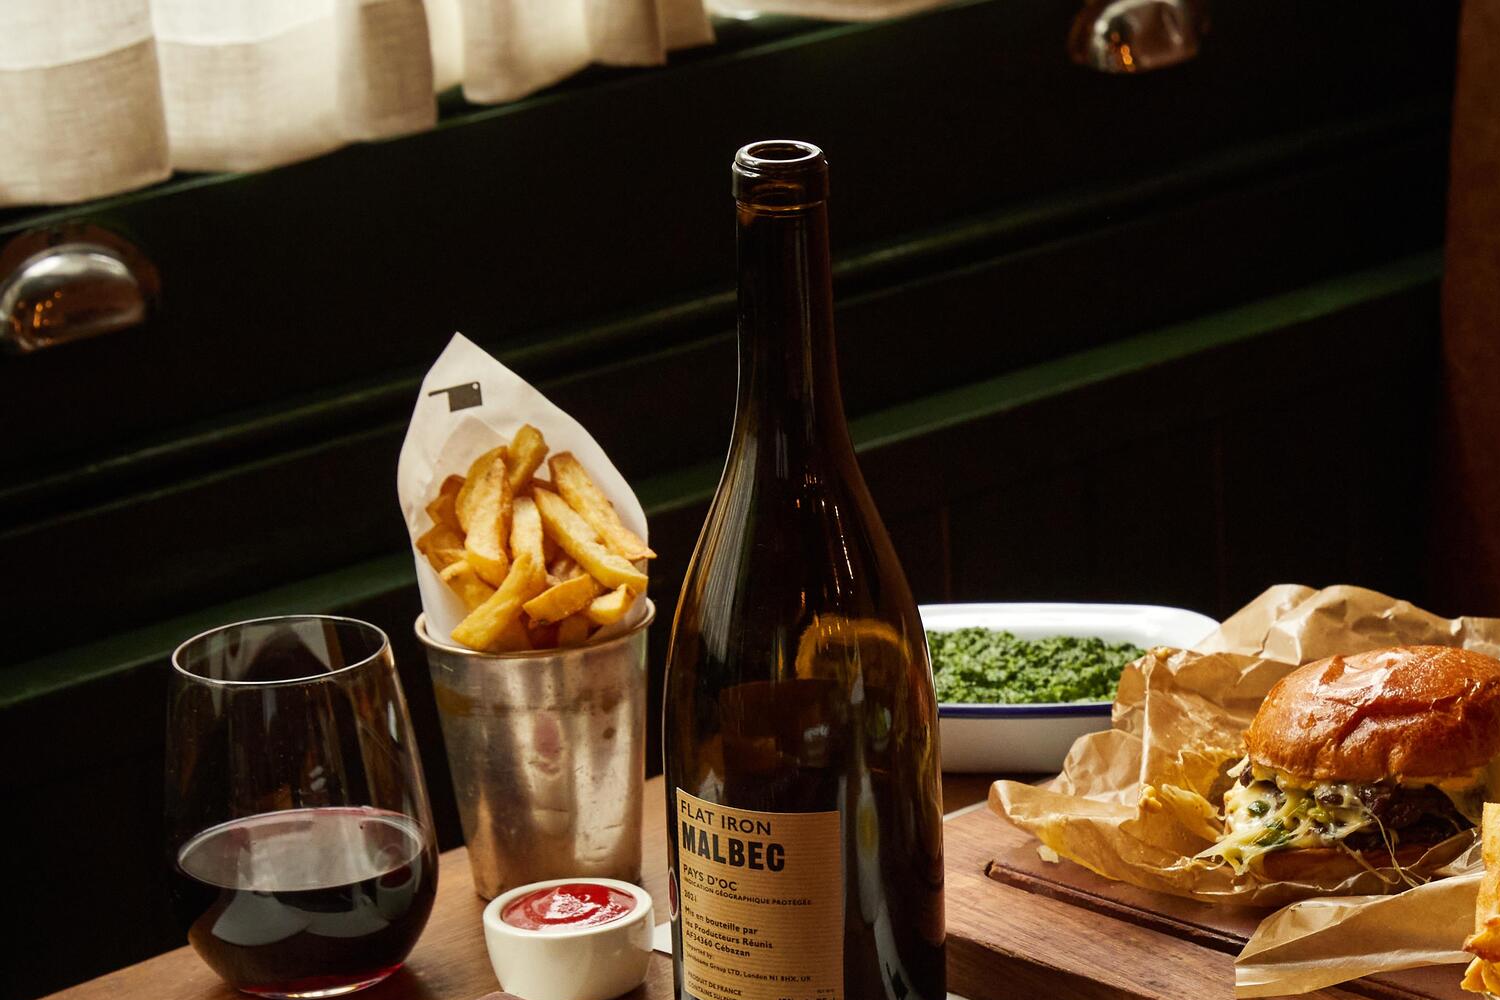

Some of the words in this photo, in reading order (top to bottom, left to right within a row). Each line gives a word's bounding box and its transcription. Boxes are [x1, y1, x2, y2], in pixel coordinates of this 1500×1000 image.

[681, 800, 714, 825] FLAT
[721, 815, 771, 836] IRON
[682, 821, 785, 872] MALBEC
[683, 864, 704, 881] PAYS
[707, 875, 737, 891] D'OC
[694, 923, 740, 944] Producteurs
[742, 937, 773, 949] Réunis
[705, 916, 740, 932] bouteille
[743, 927, 759, 936] par
[714, 942, 751, 957] Cébazan
